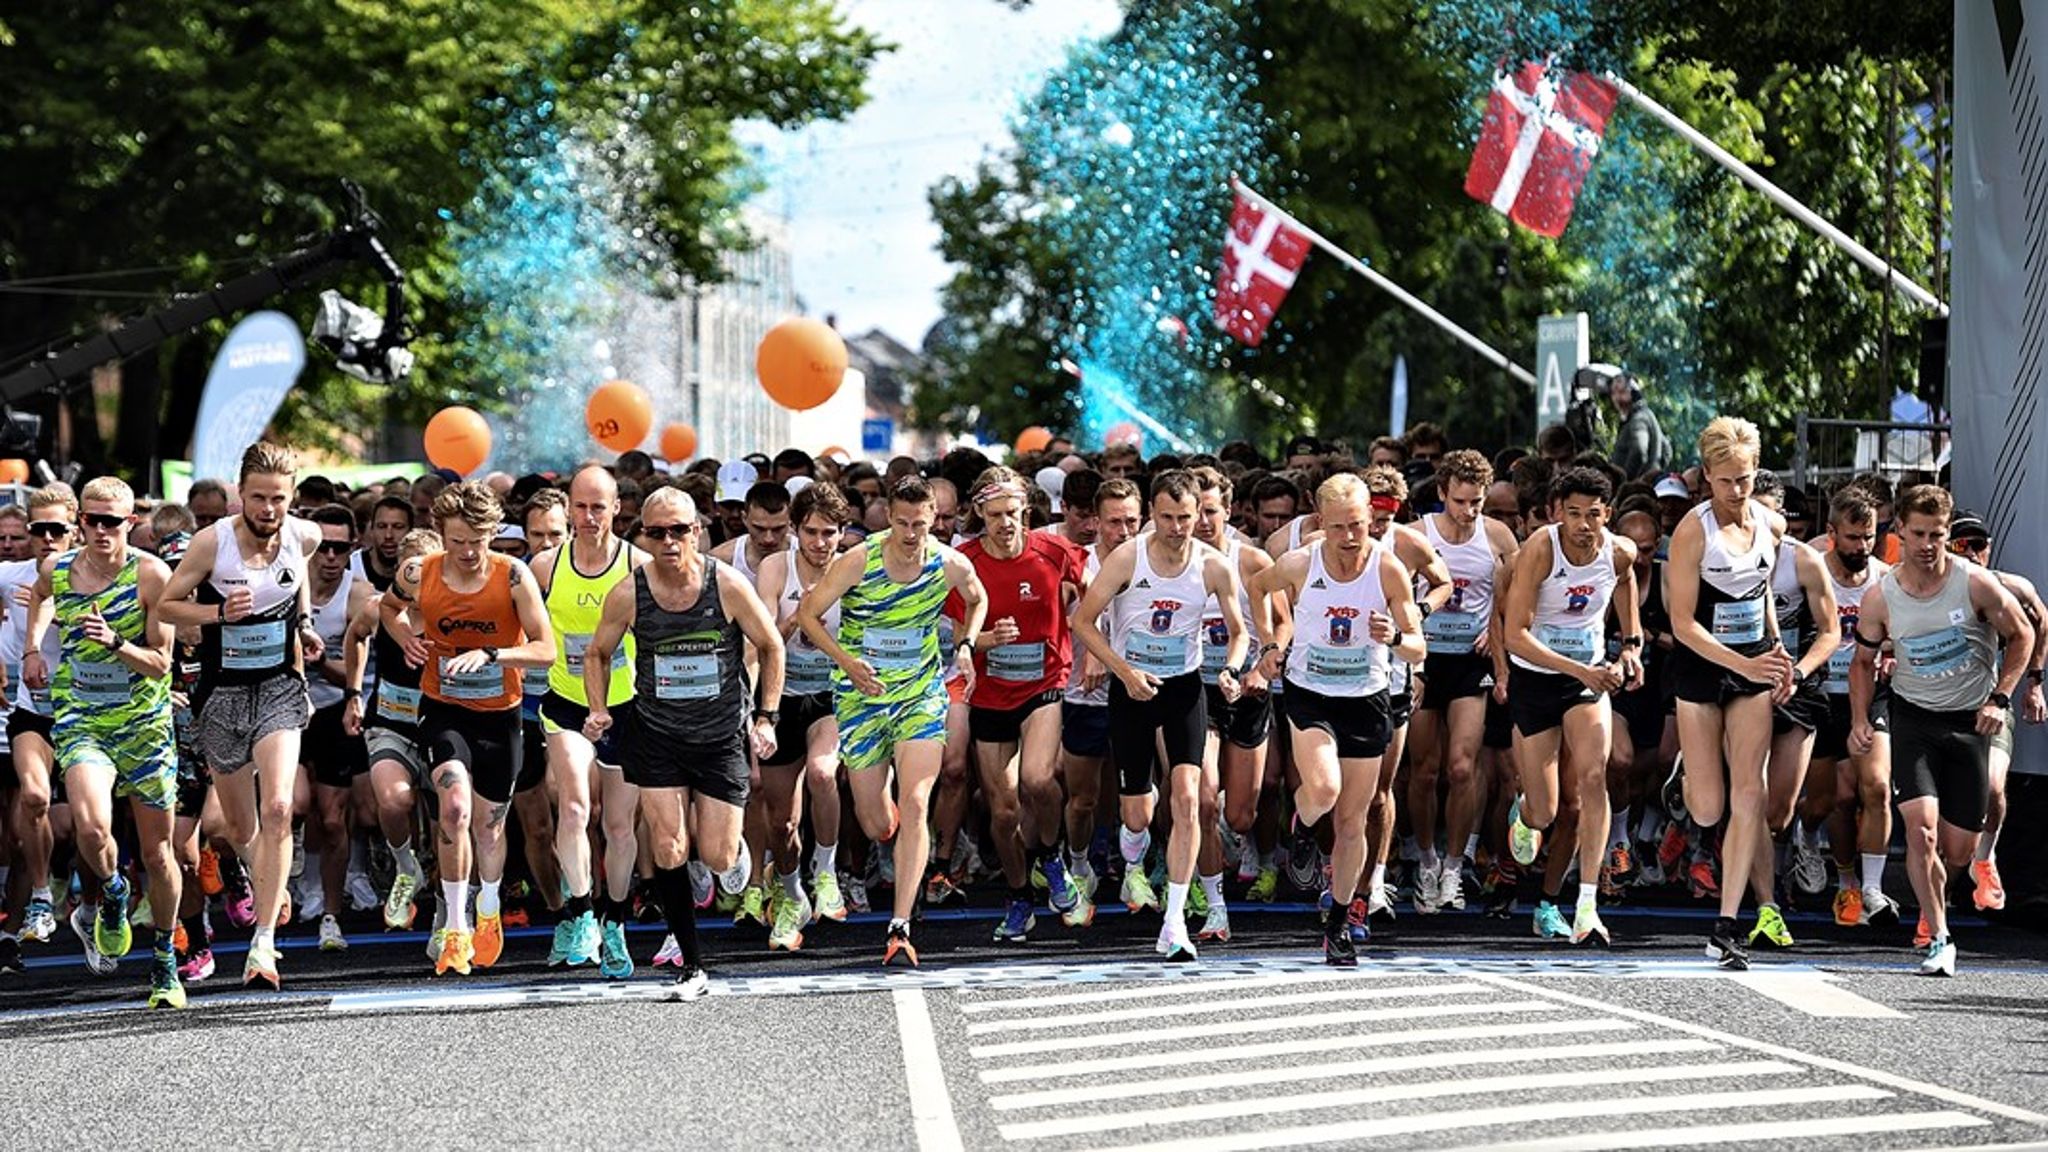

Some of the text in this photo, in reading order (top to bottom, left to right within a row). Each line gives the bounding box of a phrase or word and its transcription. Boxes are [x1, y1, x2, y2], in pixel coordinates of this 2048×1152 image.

[1539, 353, 1567, 414] A
[595, 418, 619, 439] 29
[673, 663, 698, 672] BRIAN
